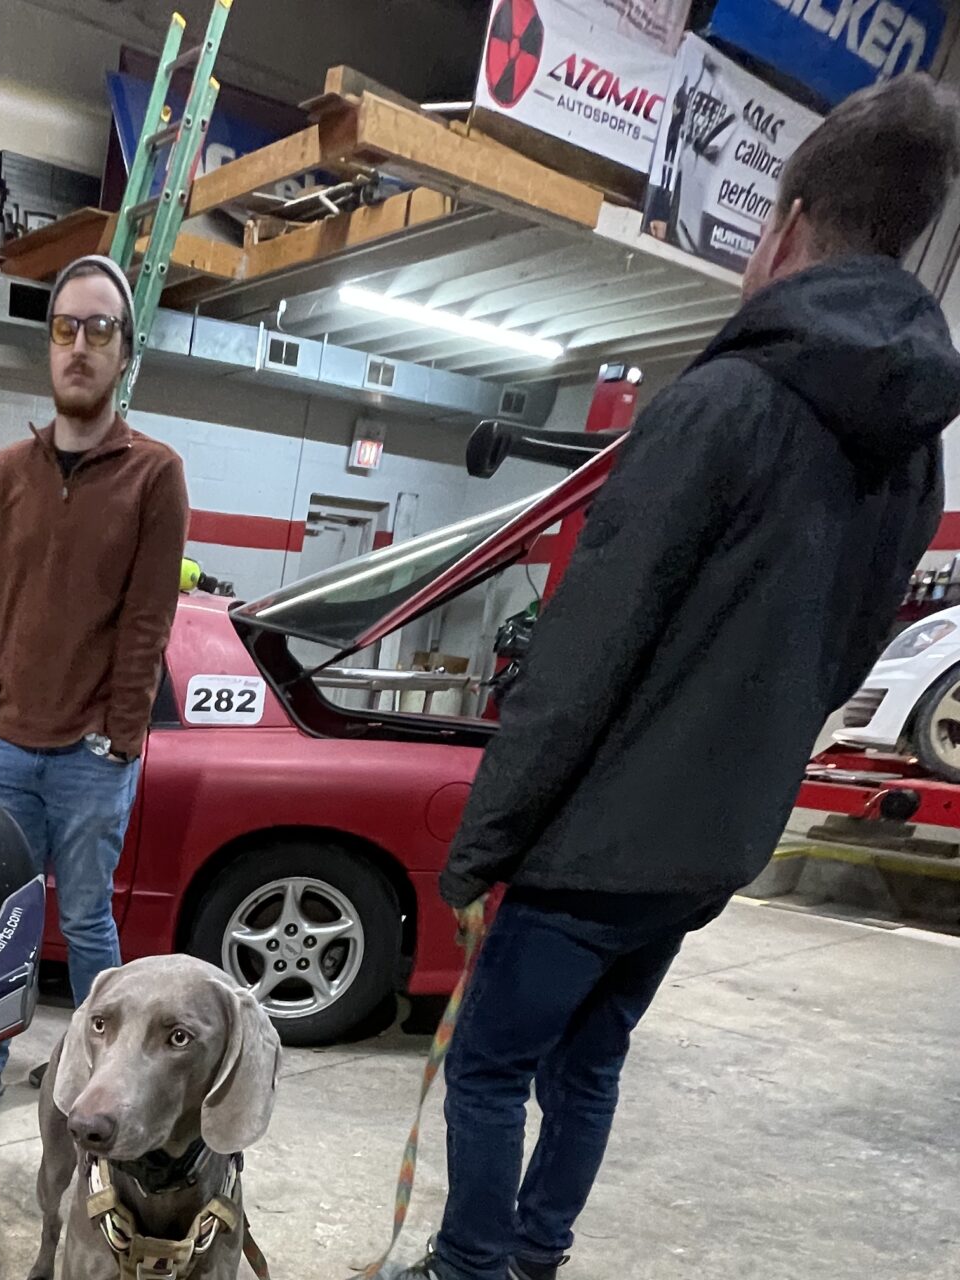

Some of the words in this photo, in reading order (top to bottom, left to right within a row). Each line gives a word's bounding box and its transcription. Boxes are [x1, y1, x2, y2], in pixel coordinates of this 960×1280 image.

[547, 53, 666, 124] ATOMIC
[557, 95, 642, 140] AUTOSPORTS
[734, 140, 784, 179] calibra
[191, 688, 256, 712] 282
